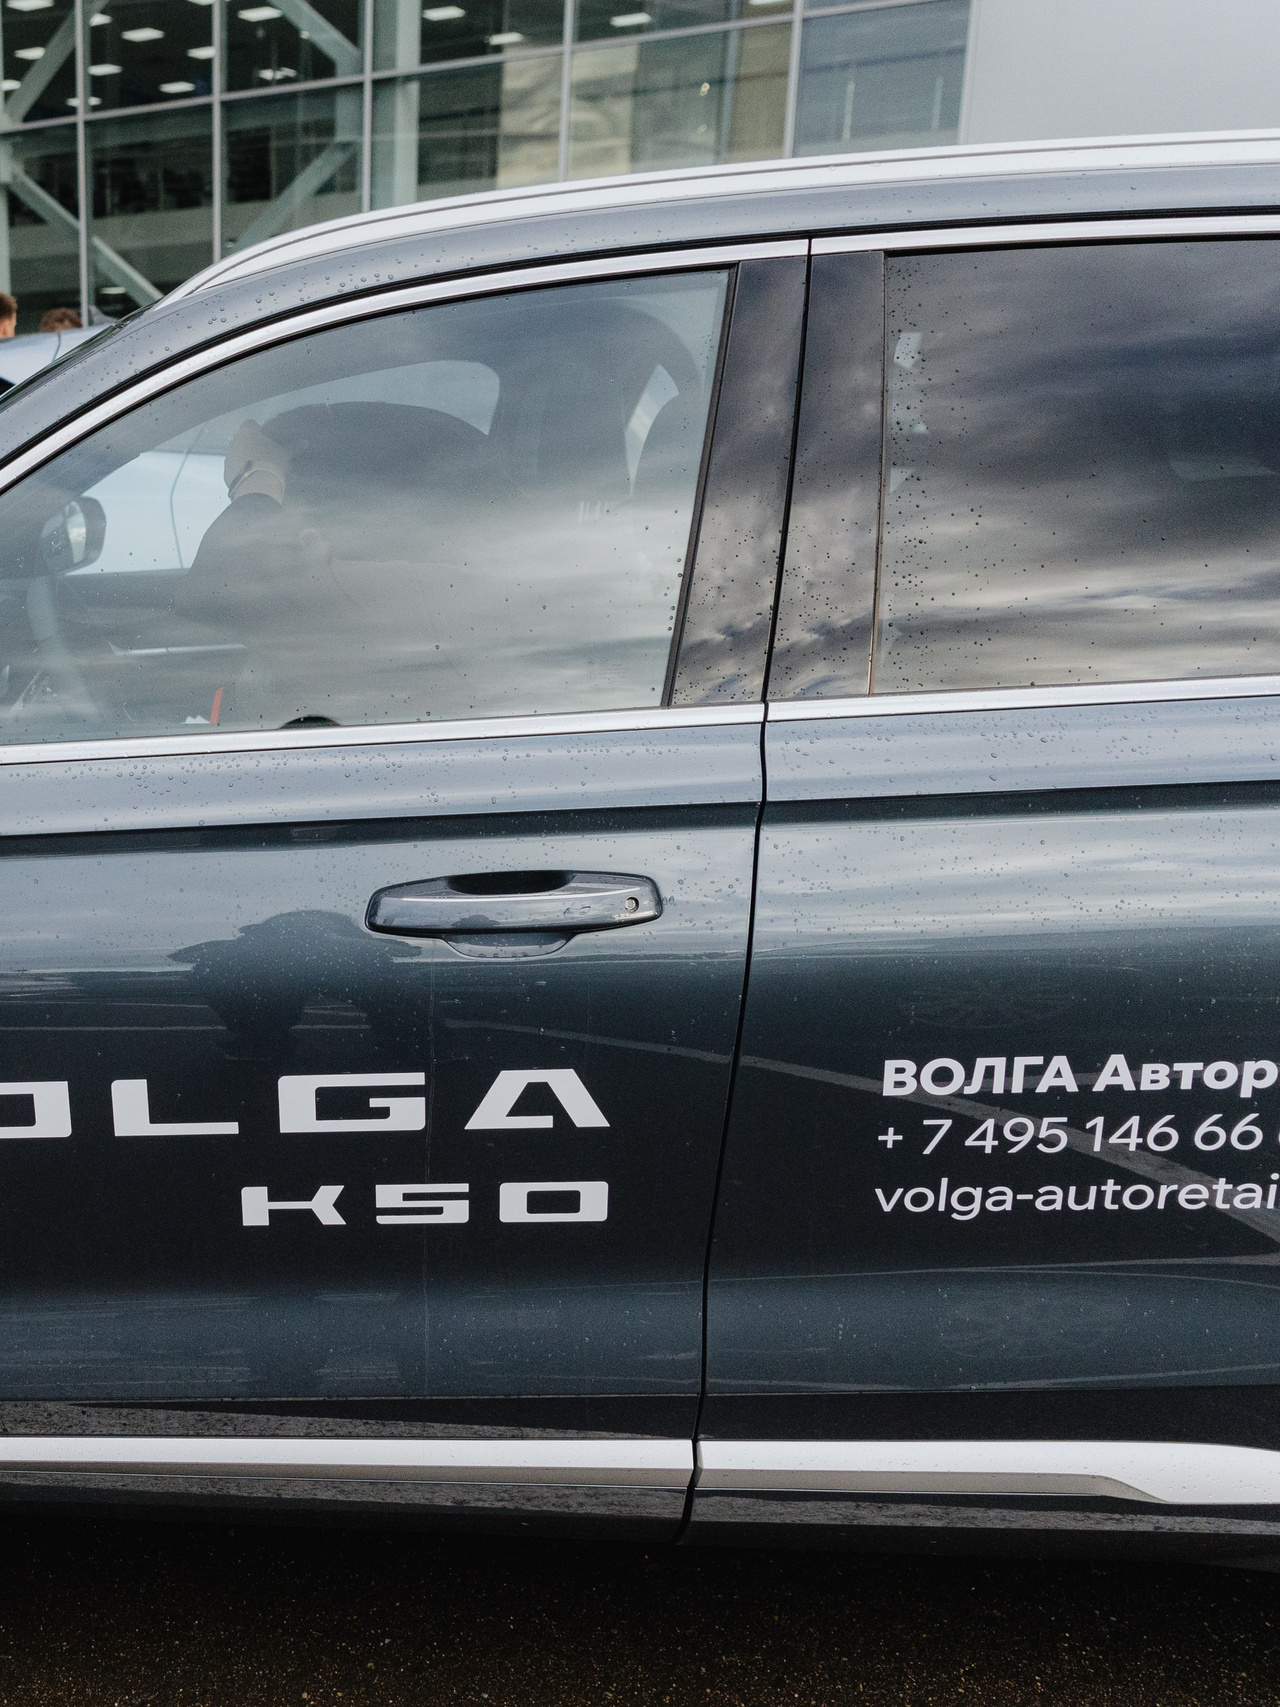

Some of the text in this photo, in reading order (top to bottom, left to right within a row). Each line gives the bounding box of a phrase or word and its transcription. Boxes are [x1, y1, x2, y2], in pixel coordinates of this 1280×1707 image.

[882, 1054, 1279, 1098] ВОЛГА Автор
[922, 1119, 953, 1155] 7
[964, 1117, 1068, 1154] 495
[1085, 1114, 1179, 1152] 146
[1193, 1113, 1264, 1151] 66
[241, 1181, 609, 1227] K50
[874, 1173, 1280, 1221] volga-autoretai
